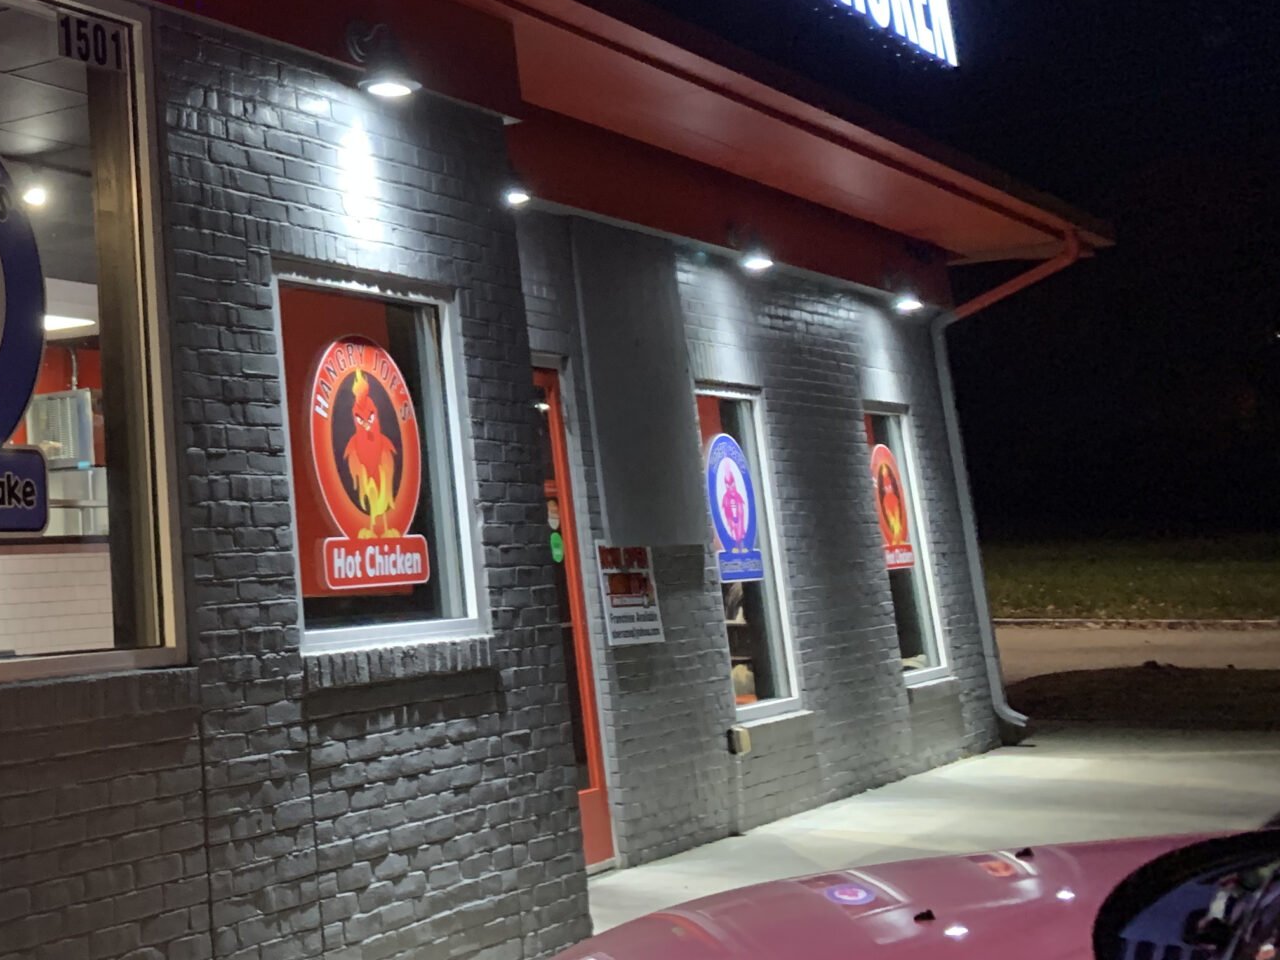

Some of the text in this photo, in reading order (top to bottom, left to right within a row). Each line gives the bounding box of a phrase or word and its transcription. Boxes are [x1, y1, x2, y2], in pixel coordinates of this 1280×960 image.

[60, 16, 122, 70] 1501
[314, 343, 365, 420] HANGRY
[333, 544, 423, 579] Hot Chicken
